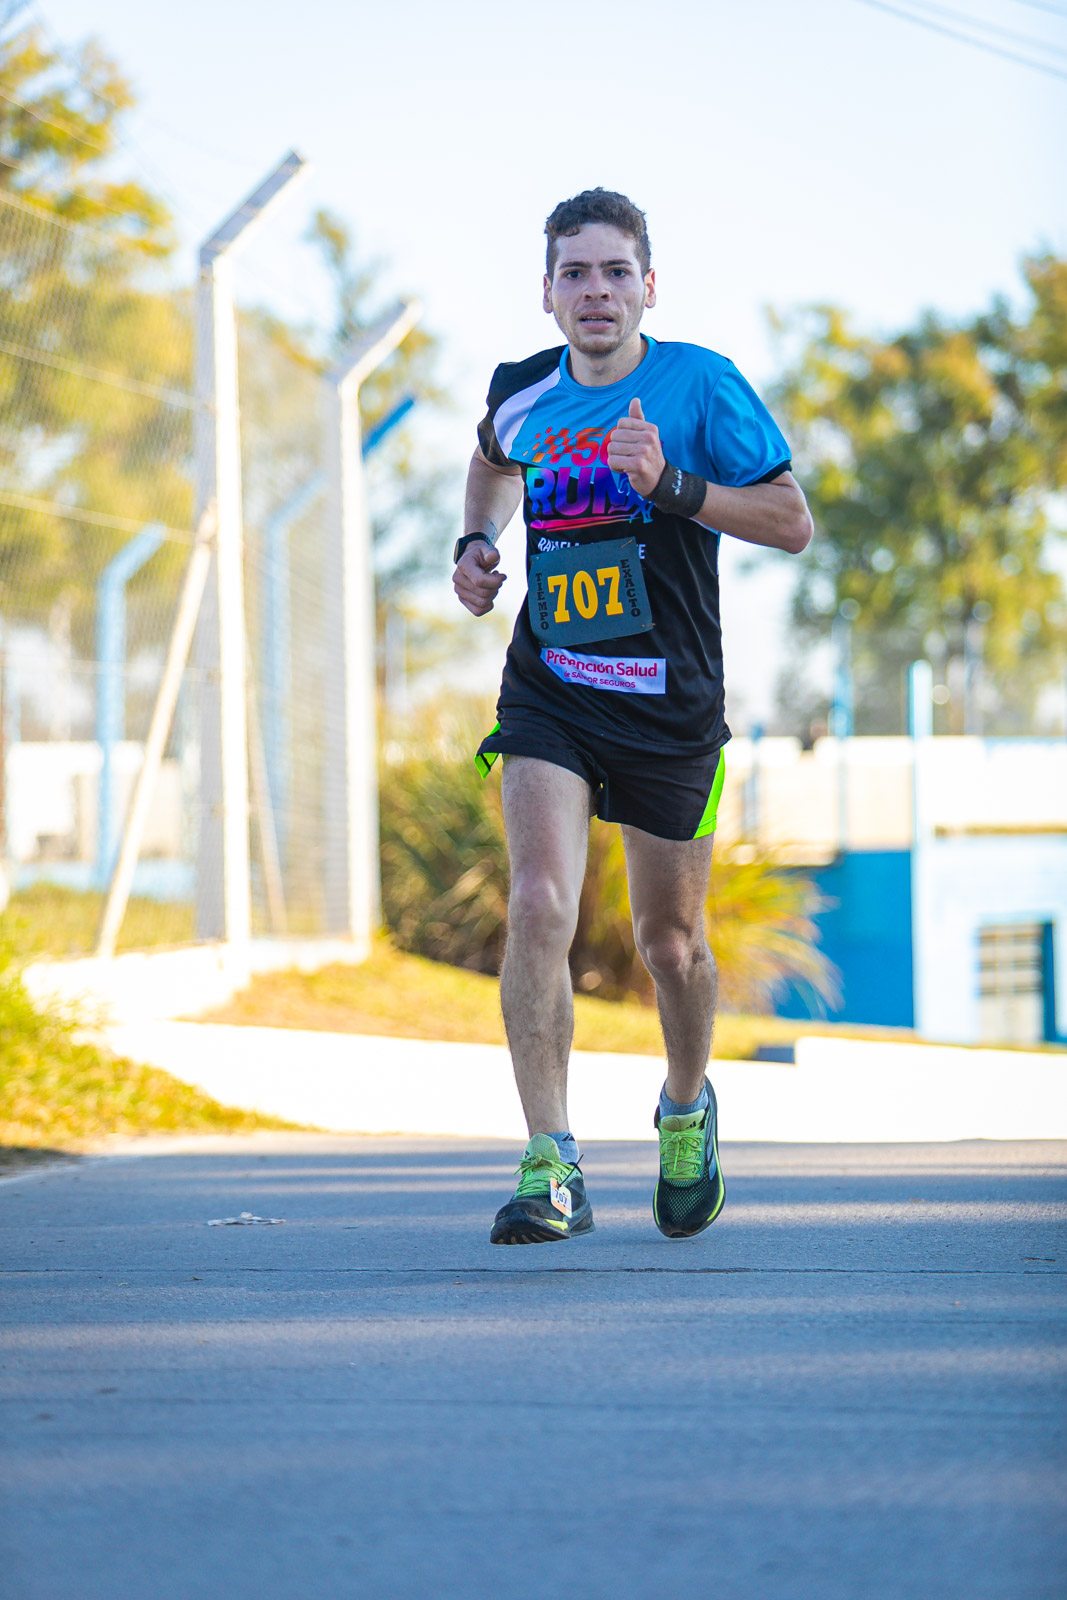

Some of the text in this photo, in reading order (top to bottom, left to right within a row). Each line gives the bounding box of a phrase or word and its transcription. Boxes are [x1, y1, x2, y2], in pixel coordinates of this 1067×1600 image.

[535, 572, 549, 631] TIEMPO
[547, 566, 624, 623] 707
[620, 559, 641, 617] EXACTO
[599, 678, 636, 689] SEGUROS
[616, 662, 658, 677] Salud
[555, 1189, 568, 1205] 707
